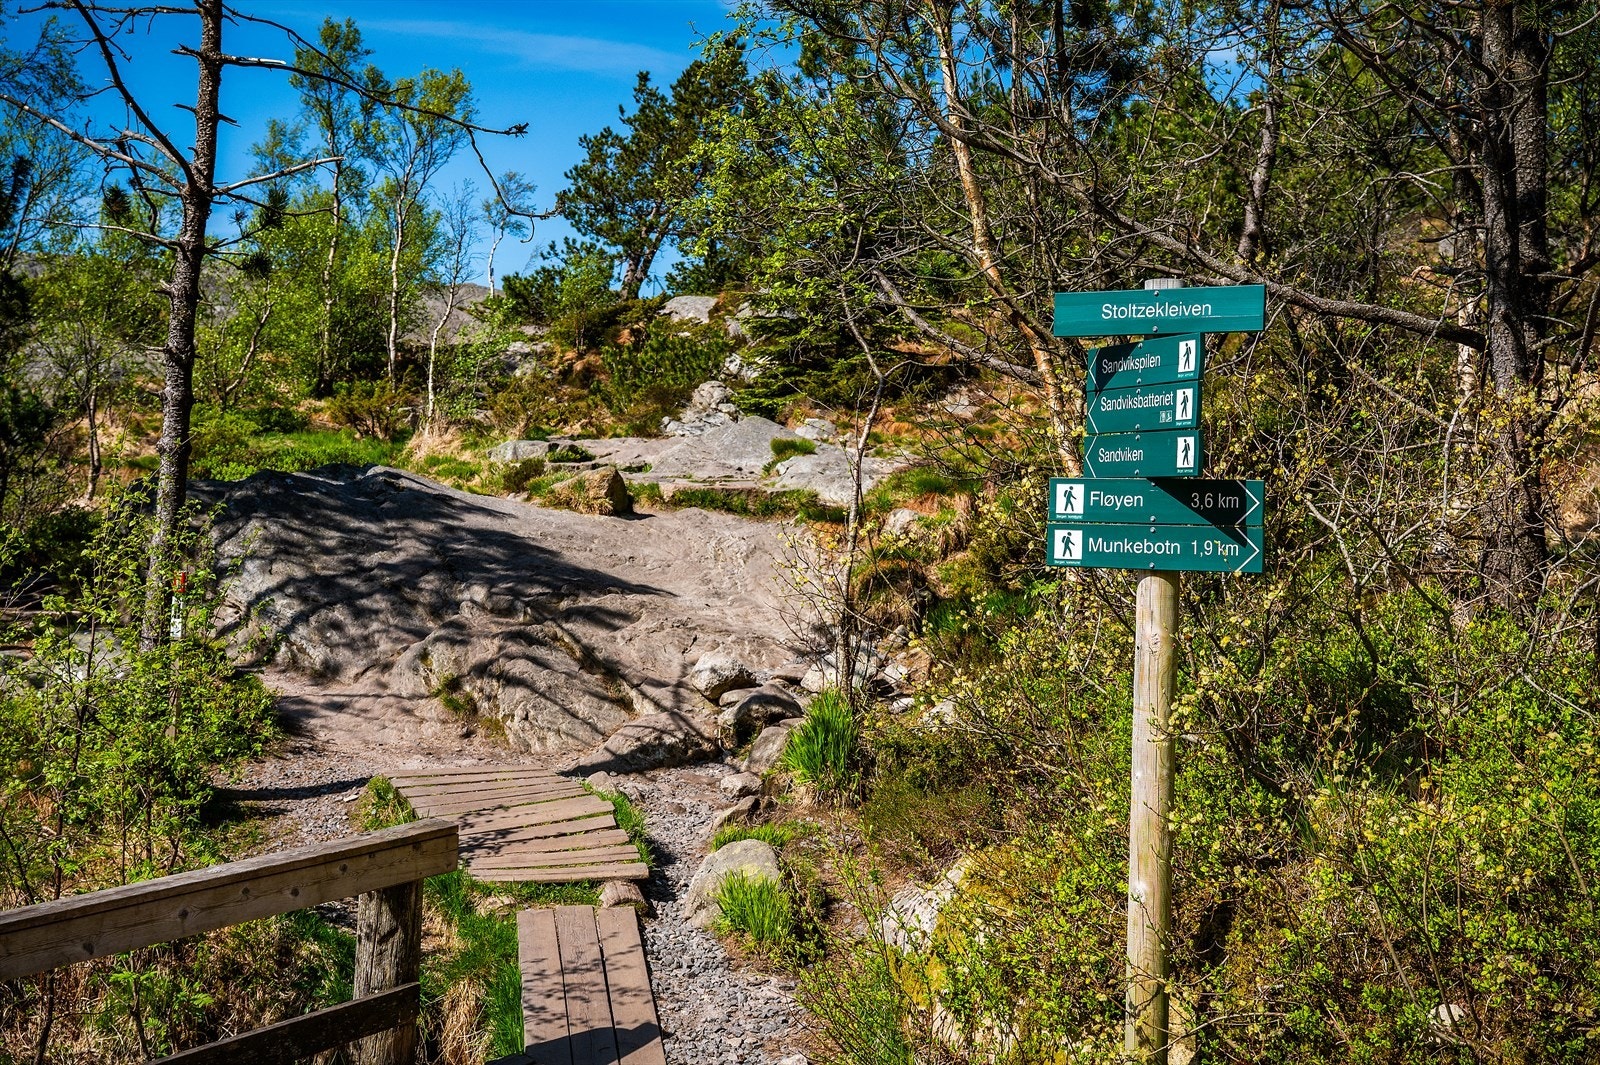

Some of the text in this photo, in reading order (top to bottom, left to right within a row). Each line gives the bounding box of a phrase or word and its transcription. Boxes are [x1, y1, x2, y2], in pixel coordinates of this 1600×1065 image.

[1102, 302, 1212, 319] Stoltzekleiven
[1102, 354, 1161, 374] Sandvikspilen
[1100, 392, 1174, 412] Sandviksbatteriet
[1098, 447, 1144, 463] Sandviken
[1090, 491, 1239, 510] Fløyen 3,6 km
[1088, 538, 1239, 558] Munkebotn 1,9 km
